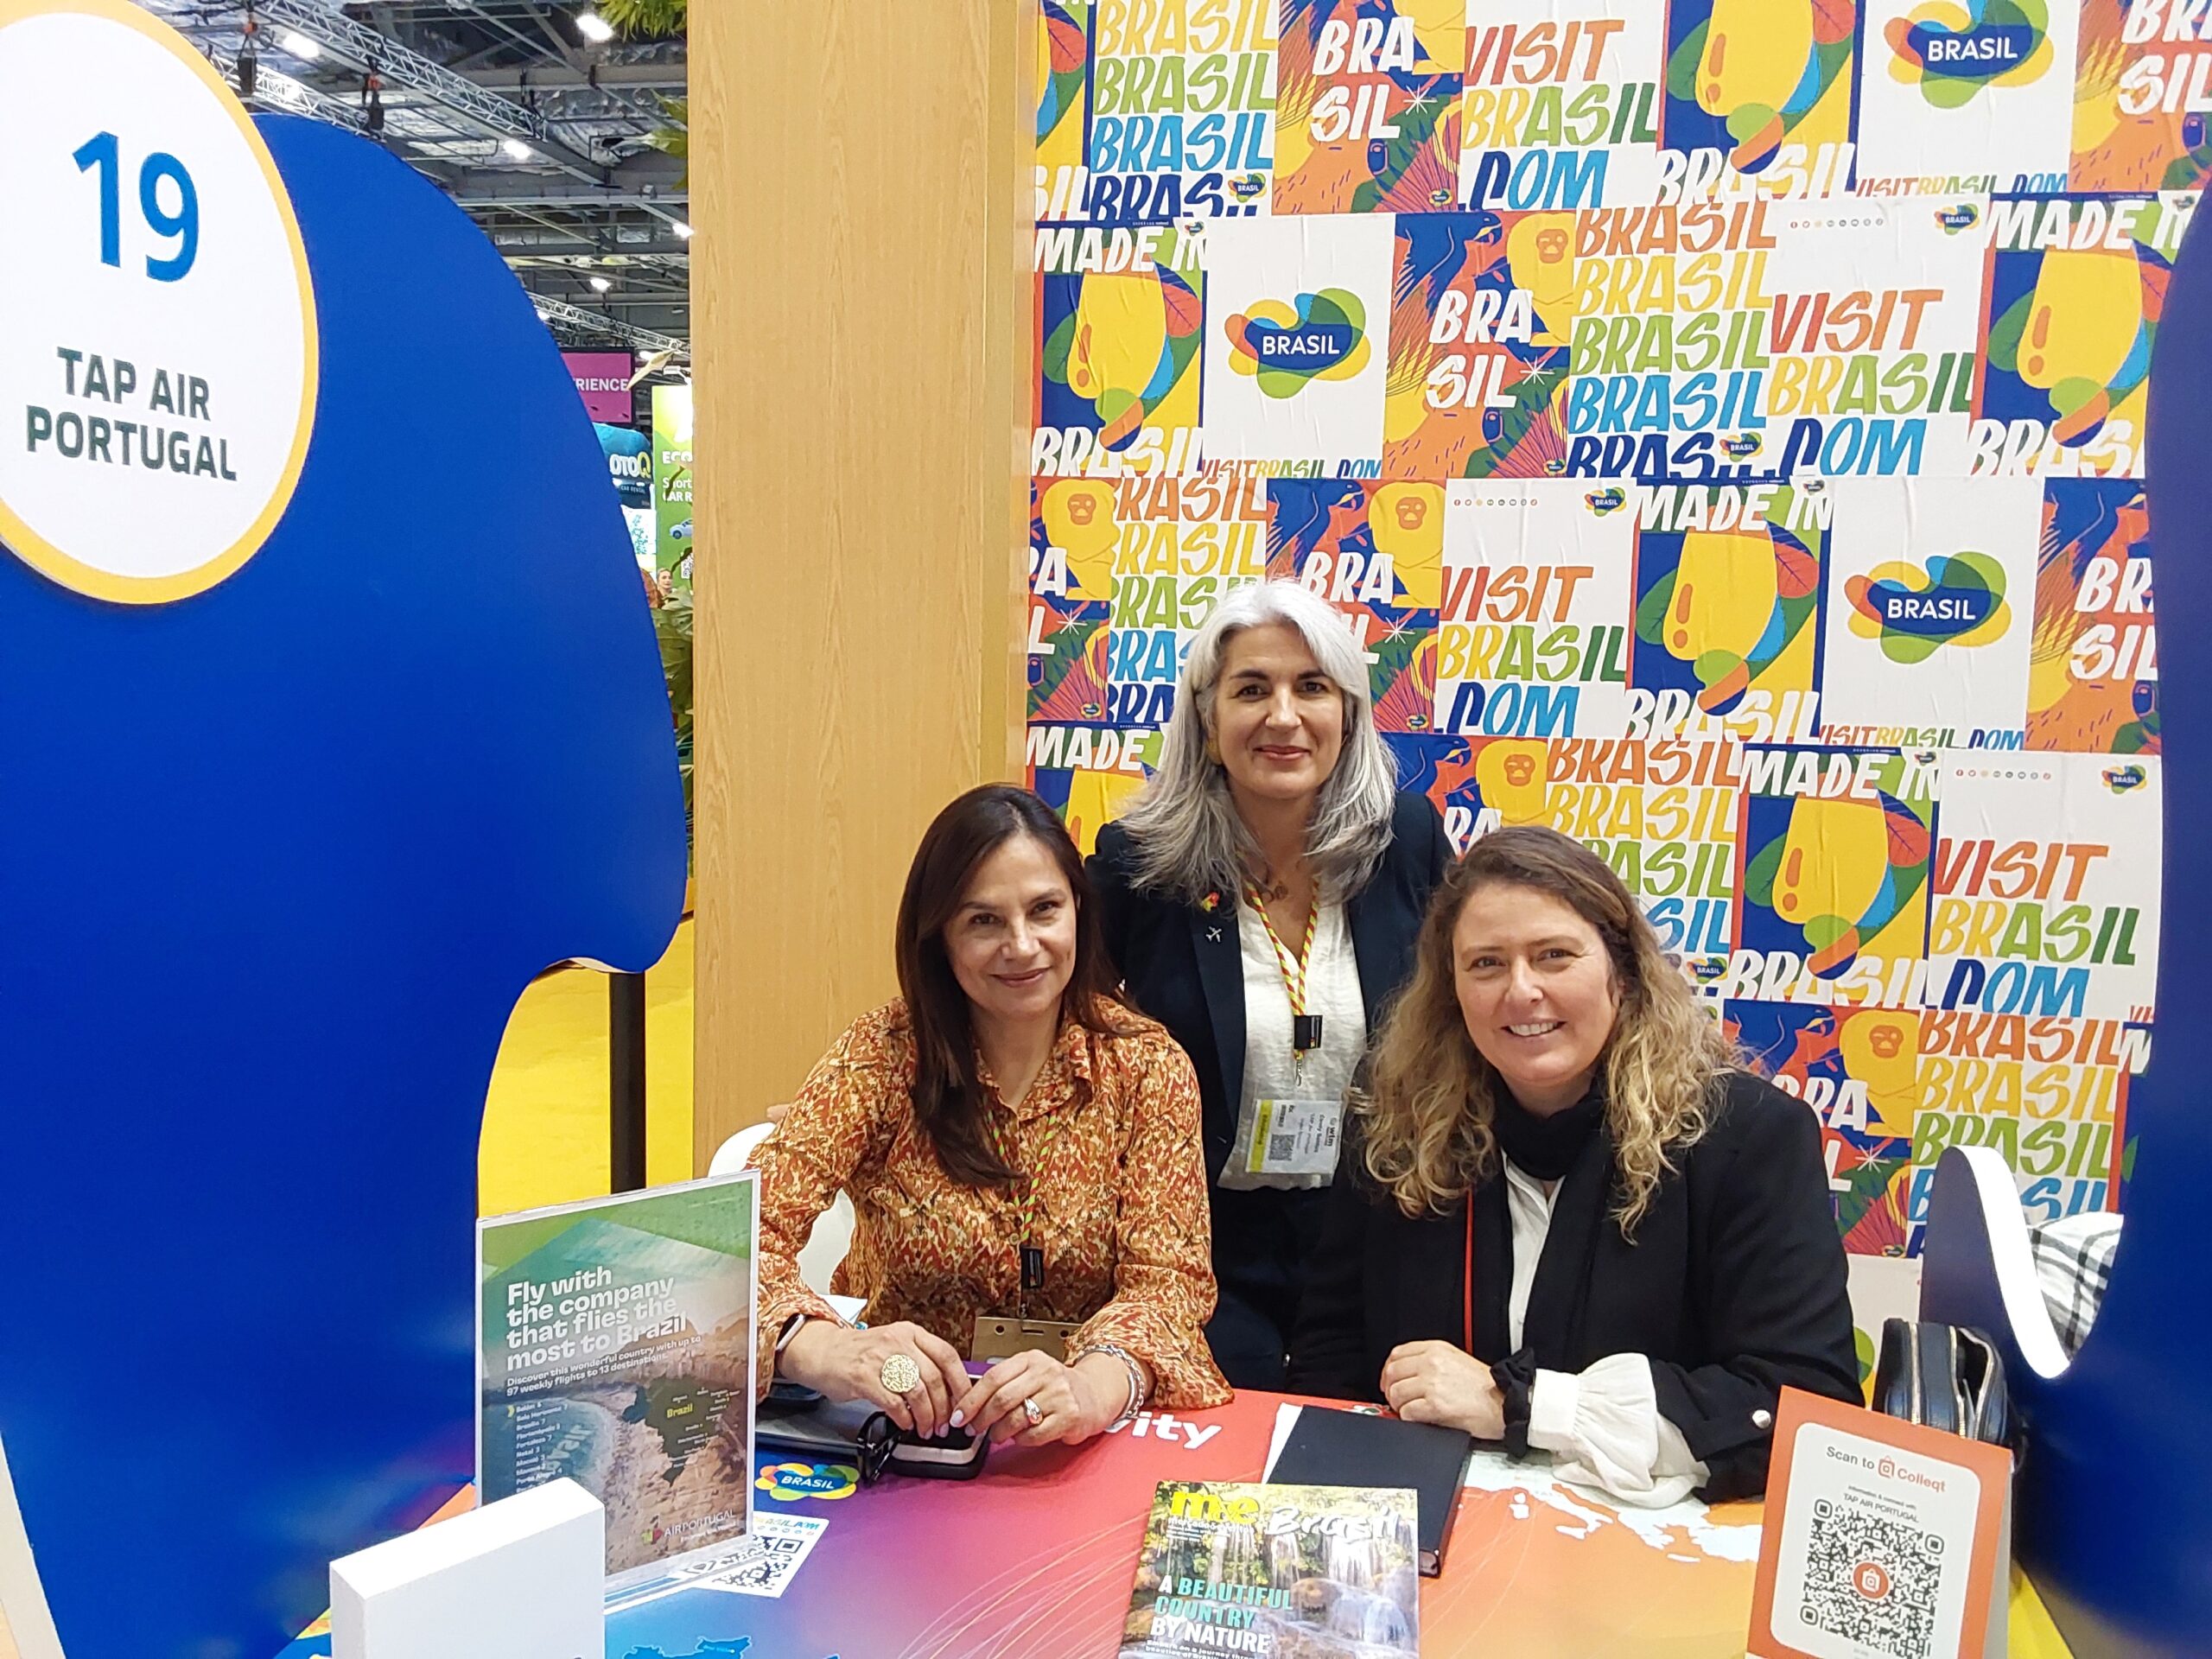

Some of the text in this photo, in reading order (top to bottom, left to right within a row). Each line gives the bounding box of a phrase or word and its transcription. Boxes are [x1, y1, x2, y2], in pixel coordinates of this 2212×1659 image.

[1096, 0, 1277, 56] BRASIL
[1315, 17, 1415, 76] BRA
[1466, 19, 1624, 85] VISIT
[1928, 36, 2018, 62] BRASIL
[1094, 52, 1275, 115] BRASIL
[2117, 53, 2212, 115] SIL
[1310, 84, 1401, 142] SIL
[1465, 82, 1657, 149] BRASIL
[1090, 112, 1274, 173] BRASIL
[1655, 143, 1857, 205] BRASIL
[73, 130, 200, 283] 19
[1987, 200, 2145, 251] MADE
[1034, 226, 1163, 275] MADE
[1573, 251, 1772, 316] BRASIL
[1428, 289, 1533, 346] BRA
[1570, 310, 1770, 376] BRASIL
[1770, 289, 1943, 354] VISIT
[1262, 335, 1340, 357] BRASIL
[56, 346, 212, 422] TAP AIR
[575, 378, 629, 391] RIENCE
[1425, 354, 1518, 409] SIL
[1568, 372, 1767, 435] BRASIL
[1768, 352, 1974, 416] BRASIL
[26, 404, 238, 481] PORTUGAL
[1032, 427, 1205, 478] BRASIL
[663, 477, 693, 489] Sort
[1636, 485, 1771, 531] MADE
[1300, 551, 1395, 604] BRA
[1439, 565, 1593, 622] VISIT
[1888, 598, 1975, 620] BRASIL
[1437, 623, 1627, 683] BRASIL
[2070, 624, 2159, 681] SIL
[1626, 688, 1821, 742] BRASIL
[1027, 726, 1147, 772] MADE
[1548, 736, 1741, 787] BRASIL
[1738, 751, 1891, 800] MADE
[1545, 785, 1737, 842] BRASIL
[1933, 838, 2108, 901] VISIT
[1930, 899, 2141, 965] BRASIL
[1731, 949, 1929, 1009] BRASIL
[1918, 1011, 2120, 1066] BRASIL
[1916, 1058, 2117, 1122] BRASIL
[506, 1277, 675, 1327] the company
[508, 1266, 612, 1306] Fly with
[506, 1296, 677, 1349] that flies the
[507, 1311, 687, 1370] most to Brazil
[506, 1385, 519, 1396] 97
[520, 1377, 554, 1395] weekly
[554, 1370, 586, 1388] flights
[587, 1368, 598, 1378] to
[599, 1364, 610, 1375] 13
[507, 1335, 702, 1387] Discover this wonderful country with up to
[666, 1403, 694, 1419] Brazil
[781, 1475, 835, 1489] BRASIL
[1827, 1446, 1946, 1493] Scan to Colleqt
[1843, 1492, 1919, 1523] TAP AIR PORTUGAL
[1154, 1595, 1255, 1629] COUNTRY
[1158, 1574, 1294, 1611] A BEAUTIFUL
[1150, 1616, 1273, 1654] BY NATURE
